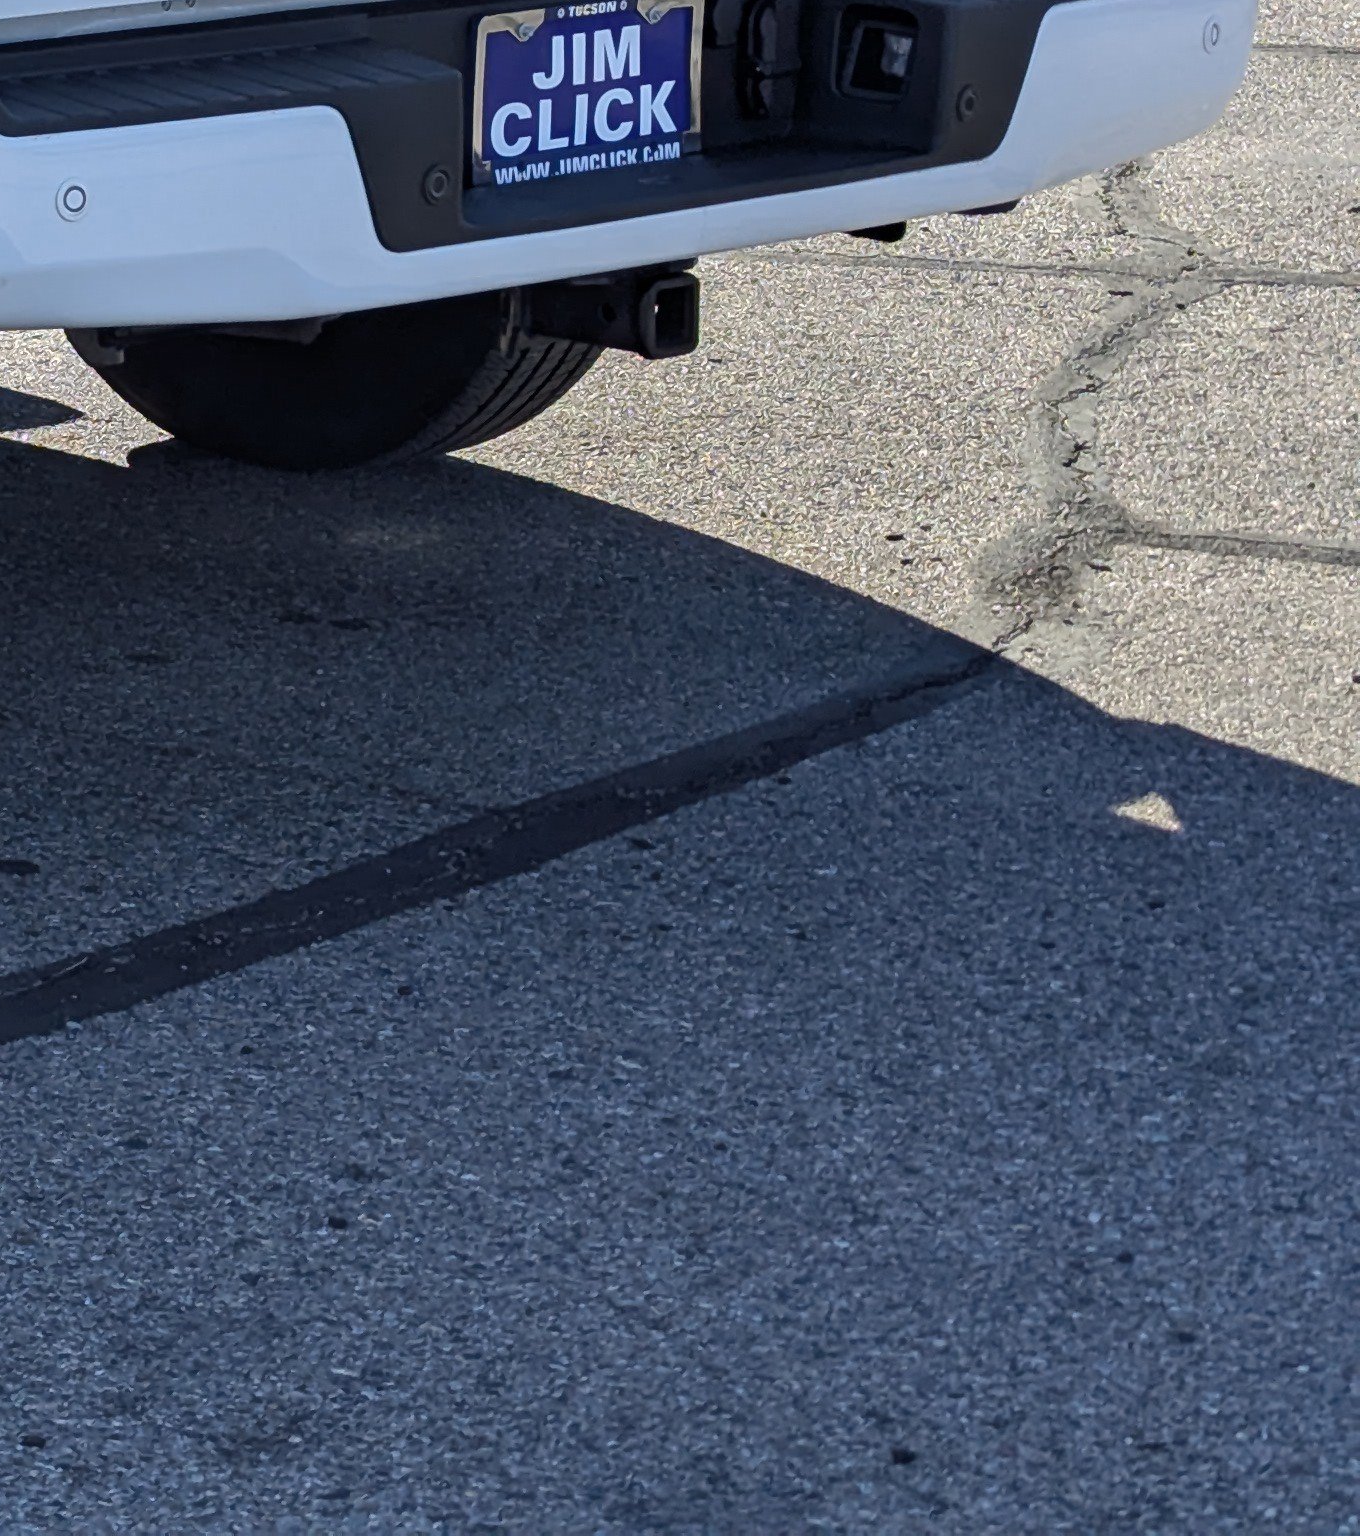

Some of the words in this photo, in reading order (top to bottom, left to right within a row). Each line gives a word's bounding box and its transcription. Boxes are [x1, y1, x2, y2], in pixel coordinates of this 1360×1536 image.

[568, 0, 617, 17] TUCSON
[532, 25, 641, 90] JIM
[490, 80, 677, 157] CLICK
